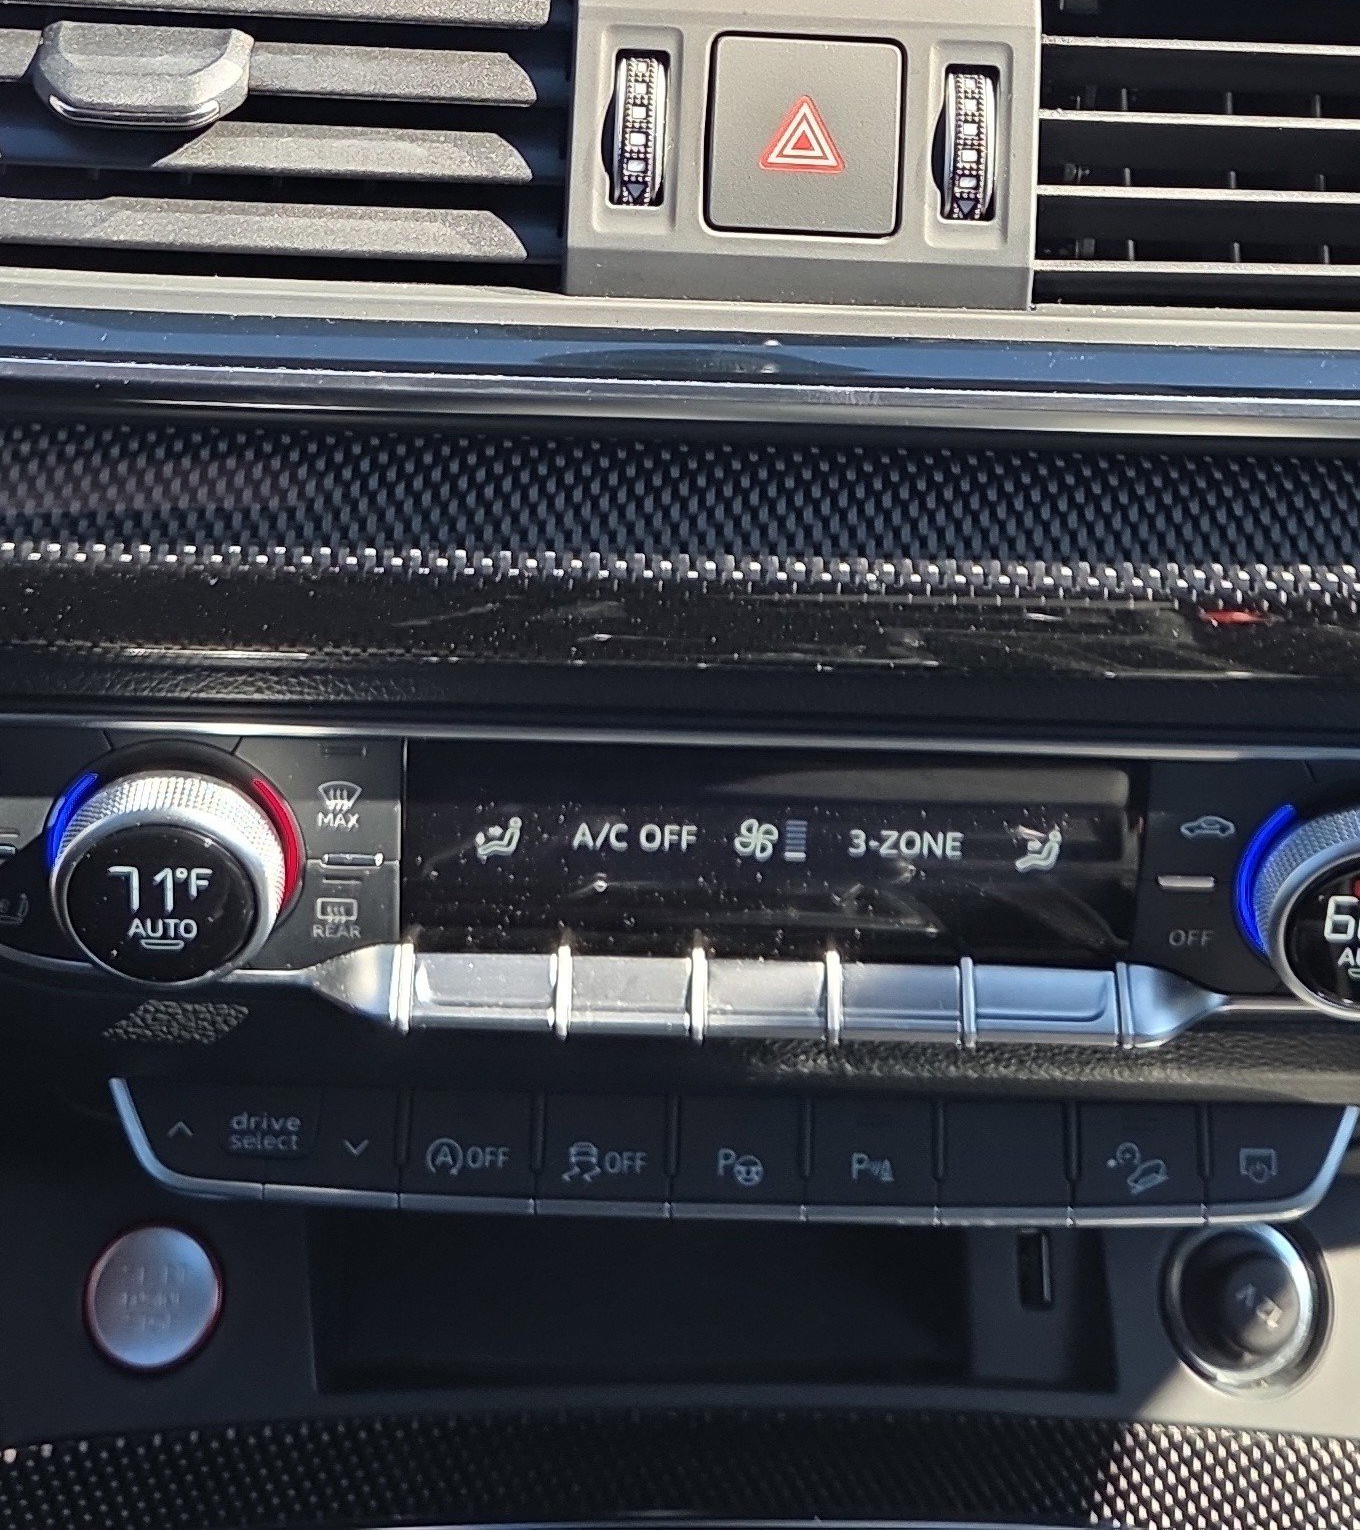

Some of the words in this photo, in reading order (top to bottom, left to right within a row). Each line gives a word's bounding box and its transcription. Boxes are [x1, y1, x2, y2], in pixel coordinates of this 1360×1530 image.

[316, 811, 359, 829] MAX
[572, 821, 629, 850] A/C
[639, 823, 698, 852] OFF
[848, 829, 964, 860] 3-ZONE
[128, 917, 198, 939] AUTO
[312, 922, 361, 938] REAR
[1168, 929, 1210, 947] OFF
[230, 1111, 301, 1132] drive
[230, 1134, 298, 1151] select
[466, 1146, 510, 1169] OFF
[603, 1151, 646, 1174] OFF
